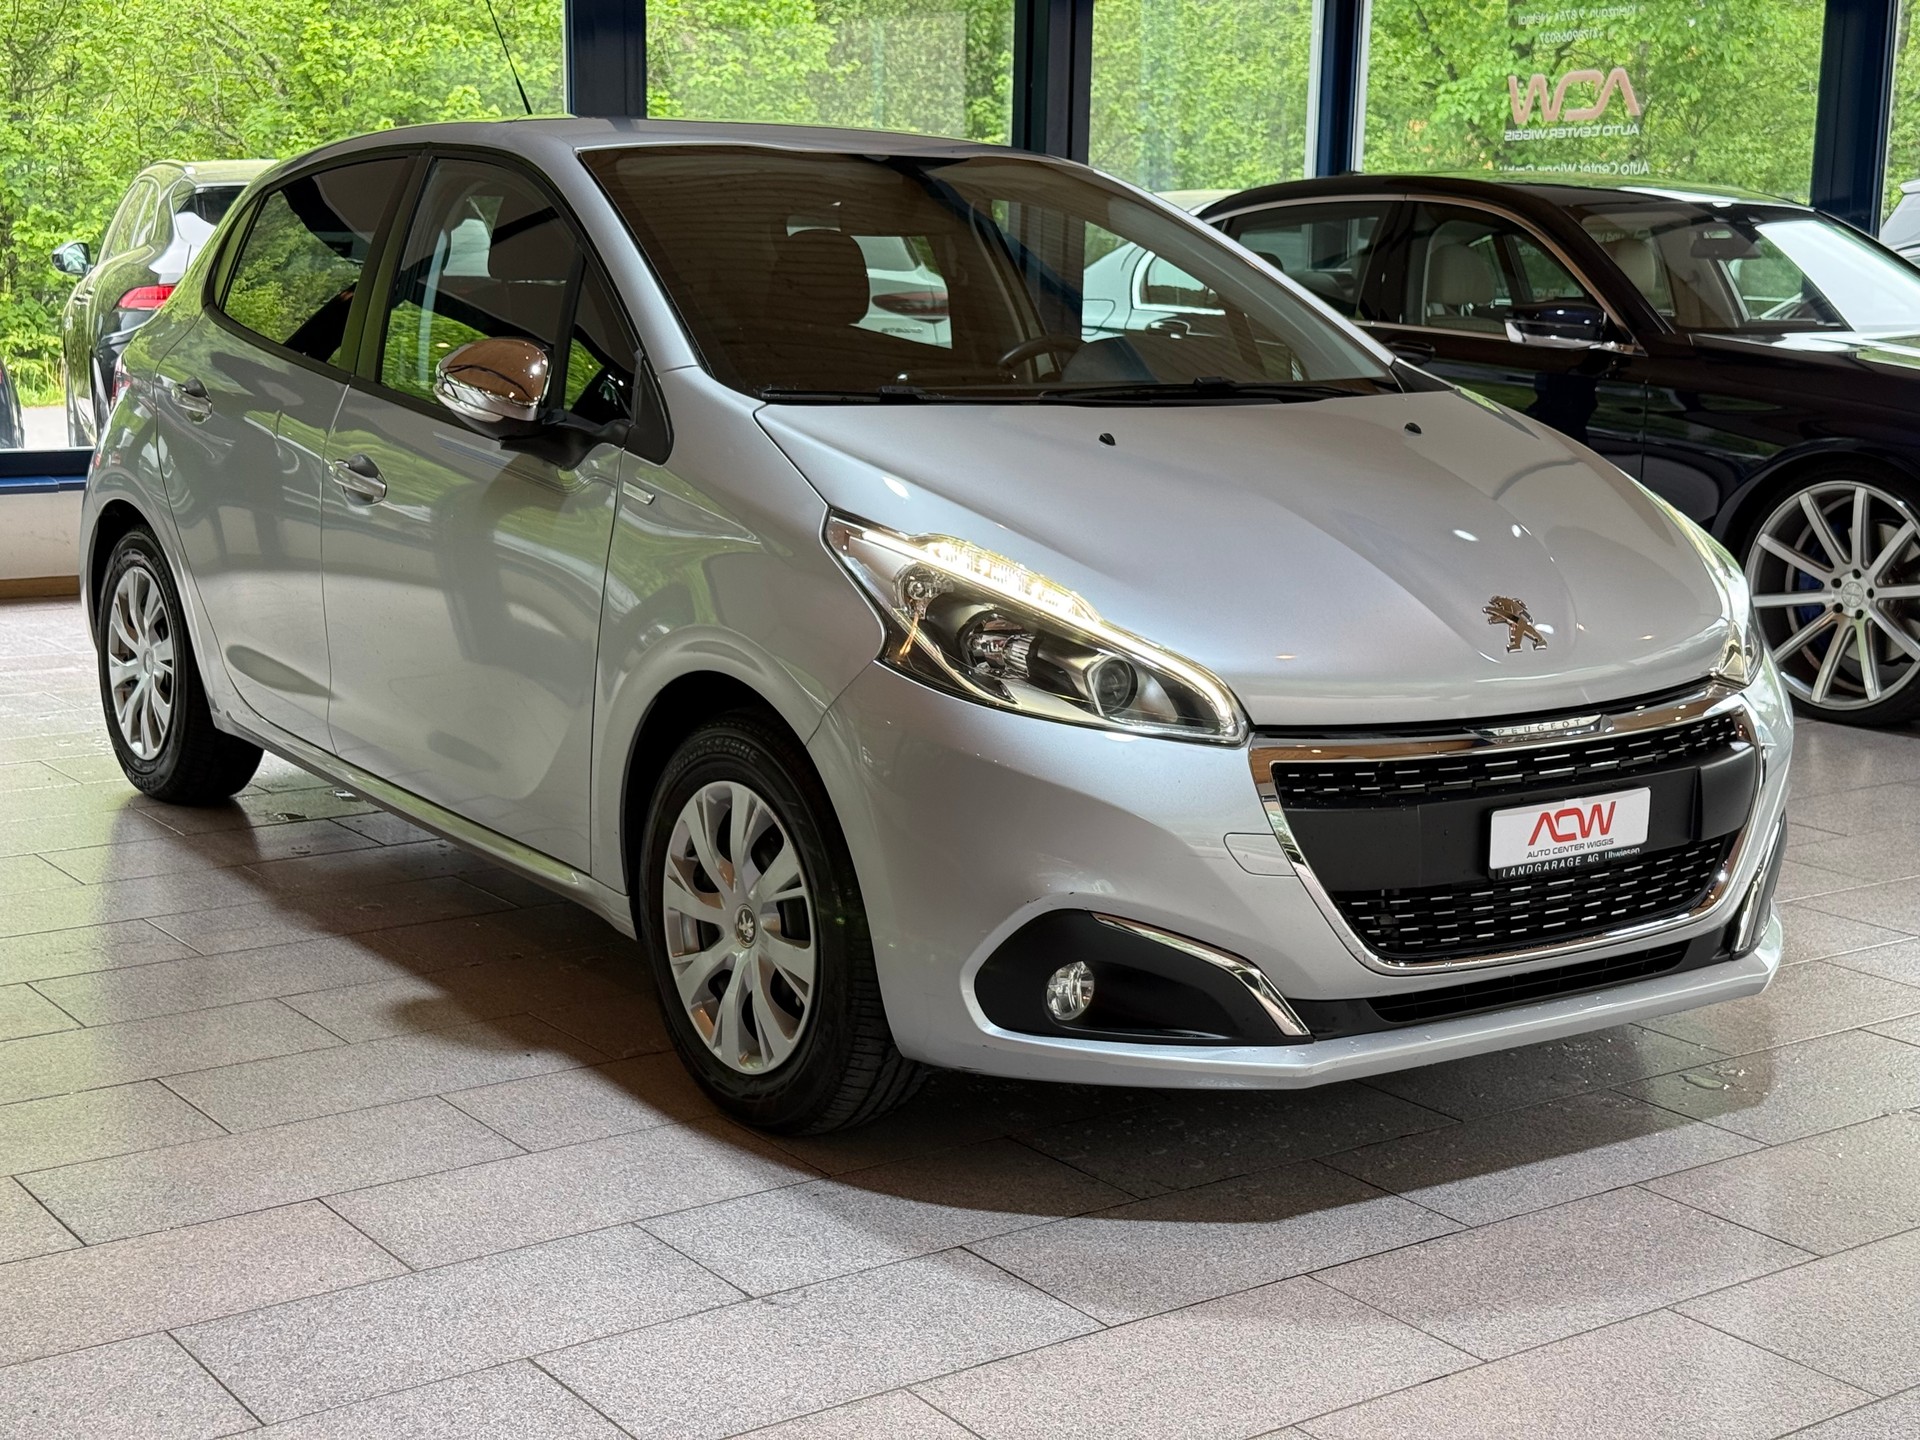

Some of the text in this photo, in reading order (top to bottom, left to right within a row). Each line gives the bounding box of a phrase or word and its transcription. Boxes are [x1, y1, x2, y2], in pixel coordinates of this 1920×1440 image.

[1497, 718, 1581, 736] PEUGEOT
[1527, 801, 1616, 847] ACW
[1526, 838, 1614, 859] AUTO CENTER WIGGIS
[1502, 856, 1582, 878] LANDGARAGE
[1587, 853, 1599, 863] AG
